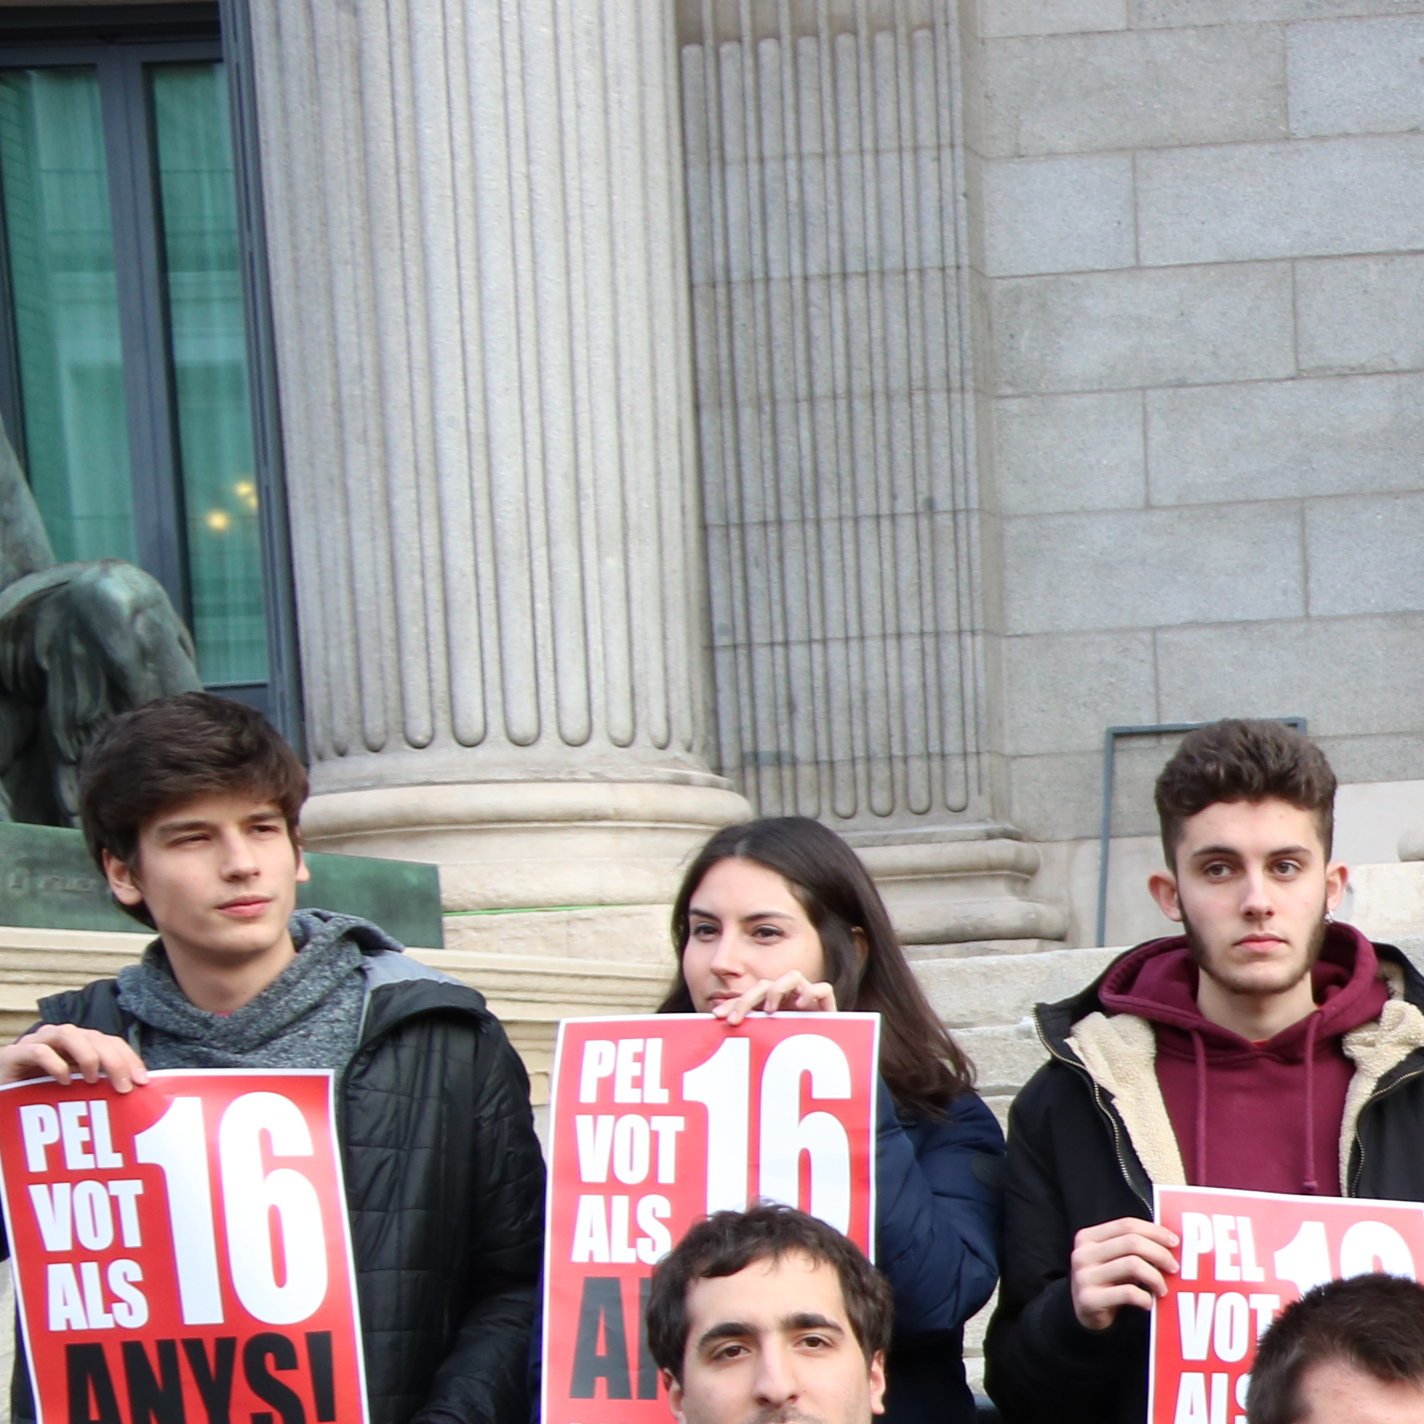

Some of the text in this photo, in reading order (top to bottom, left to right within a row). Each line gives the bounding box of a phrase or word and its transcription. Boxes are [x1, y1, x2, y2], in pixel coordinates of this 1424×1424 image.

[579, 1039, 668, 1103] PEL
[19, 1099, 124, 1171] PEL
[575, 1113, 685, 1186] VOT
[683, 1033, 852, 1238] 16
[27, 1179, 144, 1252] VOT
[133, 1091, 329, 1325] 16
[571, 1194, 674, 1264] ALS
[1180, 1211, 1264, 1283] PEL
[46, 1258, 149, 1332] ALS
